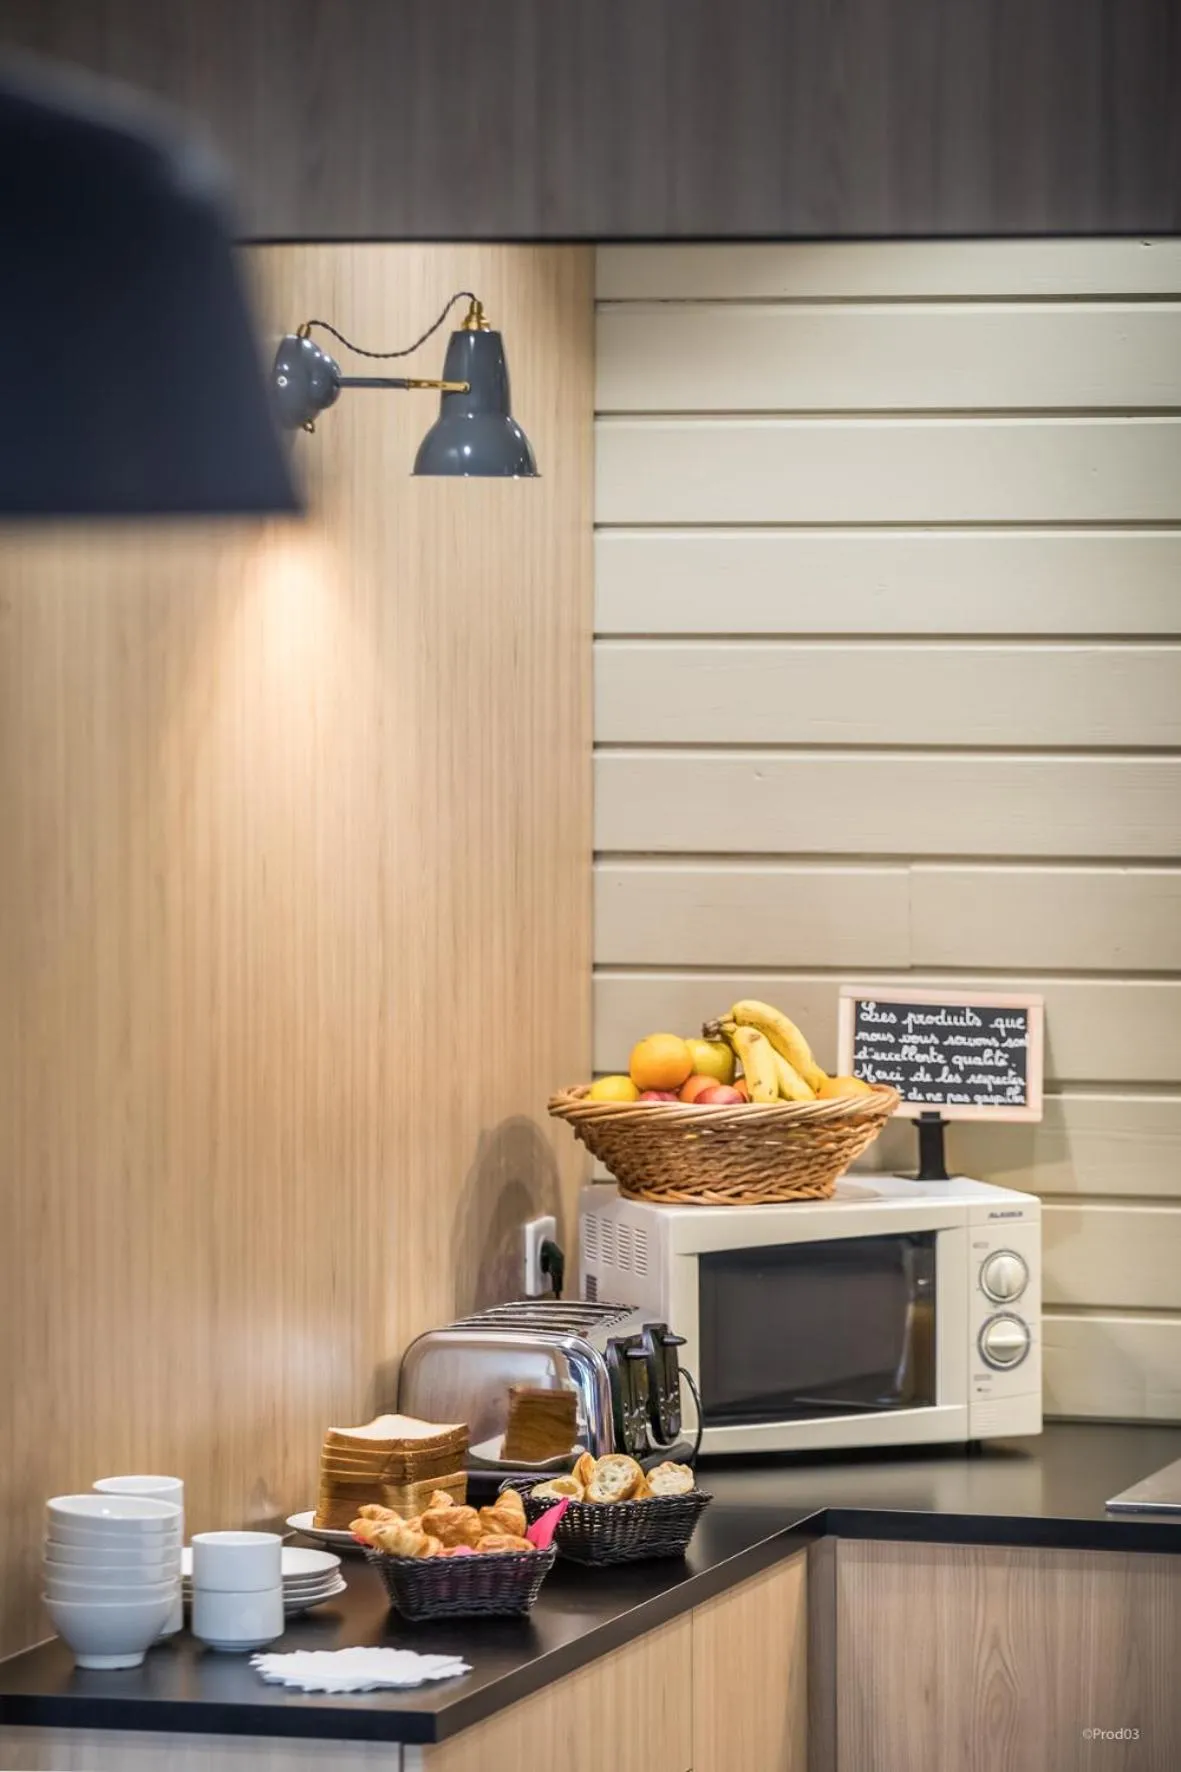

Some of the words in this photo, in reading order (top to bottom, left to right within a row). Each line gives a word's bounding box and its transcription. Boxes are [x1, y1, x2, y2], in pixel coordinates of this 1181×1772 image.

[901, 1007, 982, 1034] produits
[988, 1016, 1026, 1037] que
[856, 1032, 896, 1044] nous
[898, 1033, 940, 1045] vous
